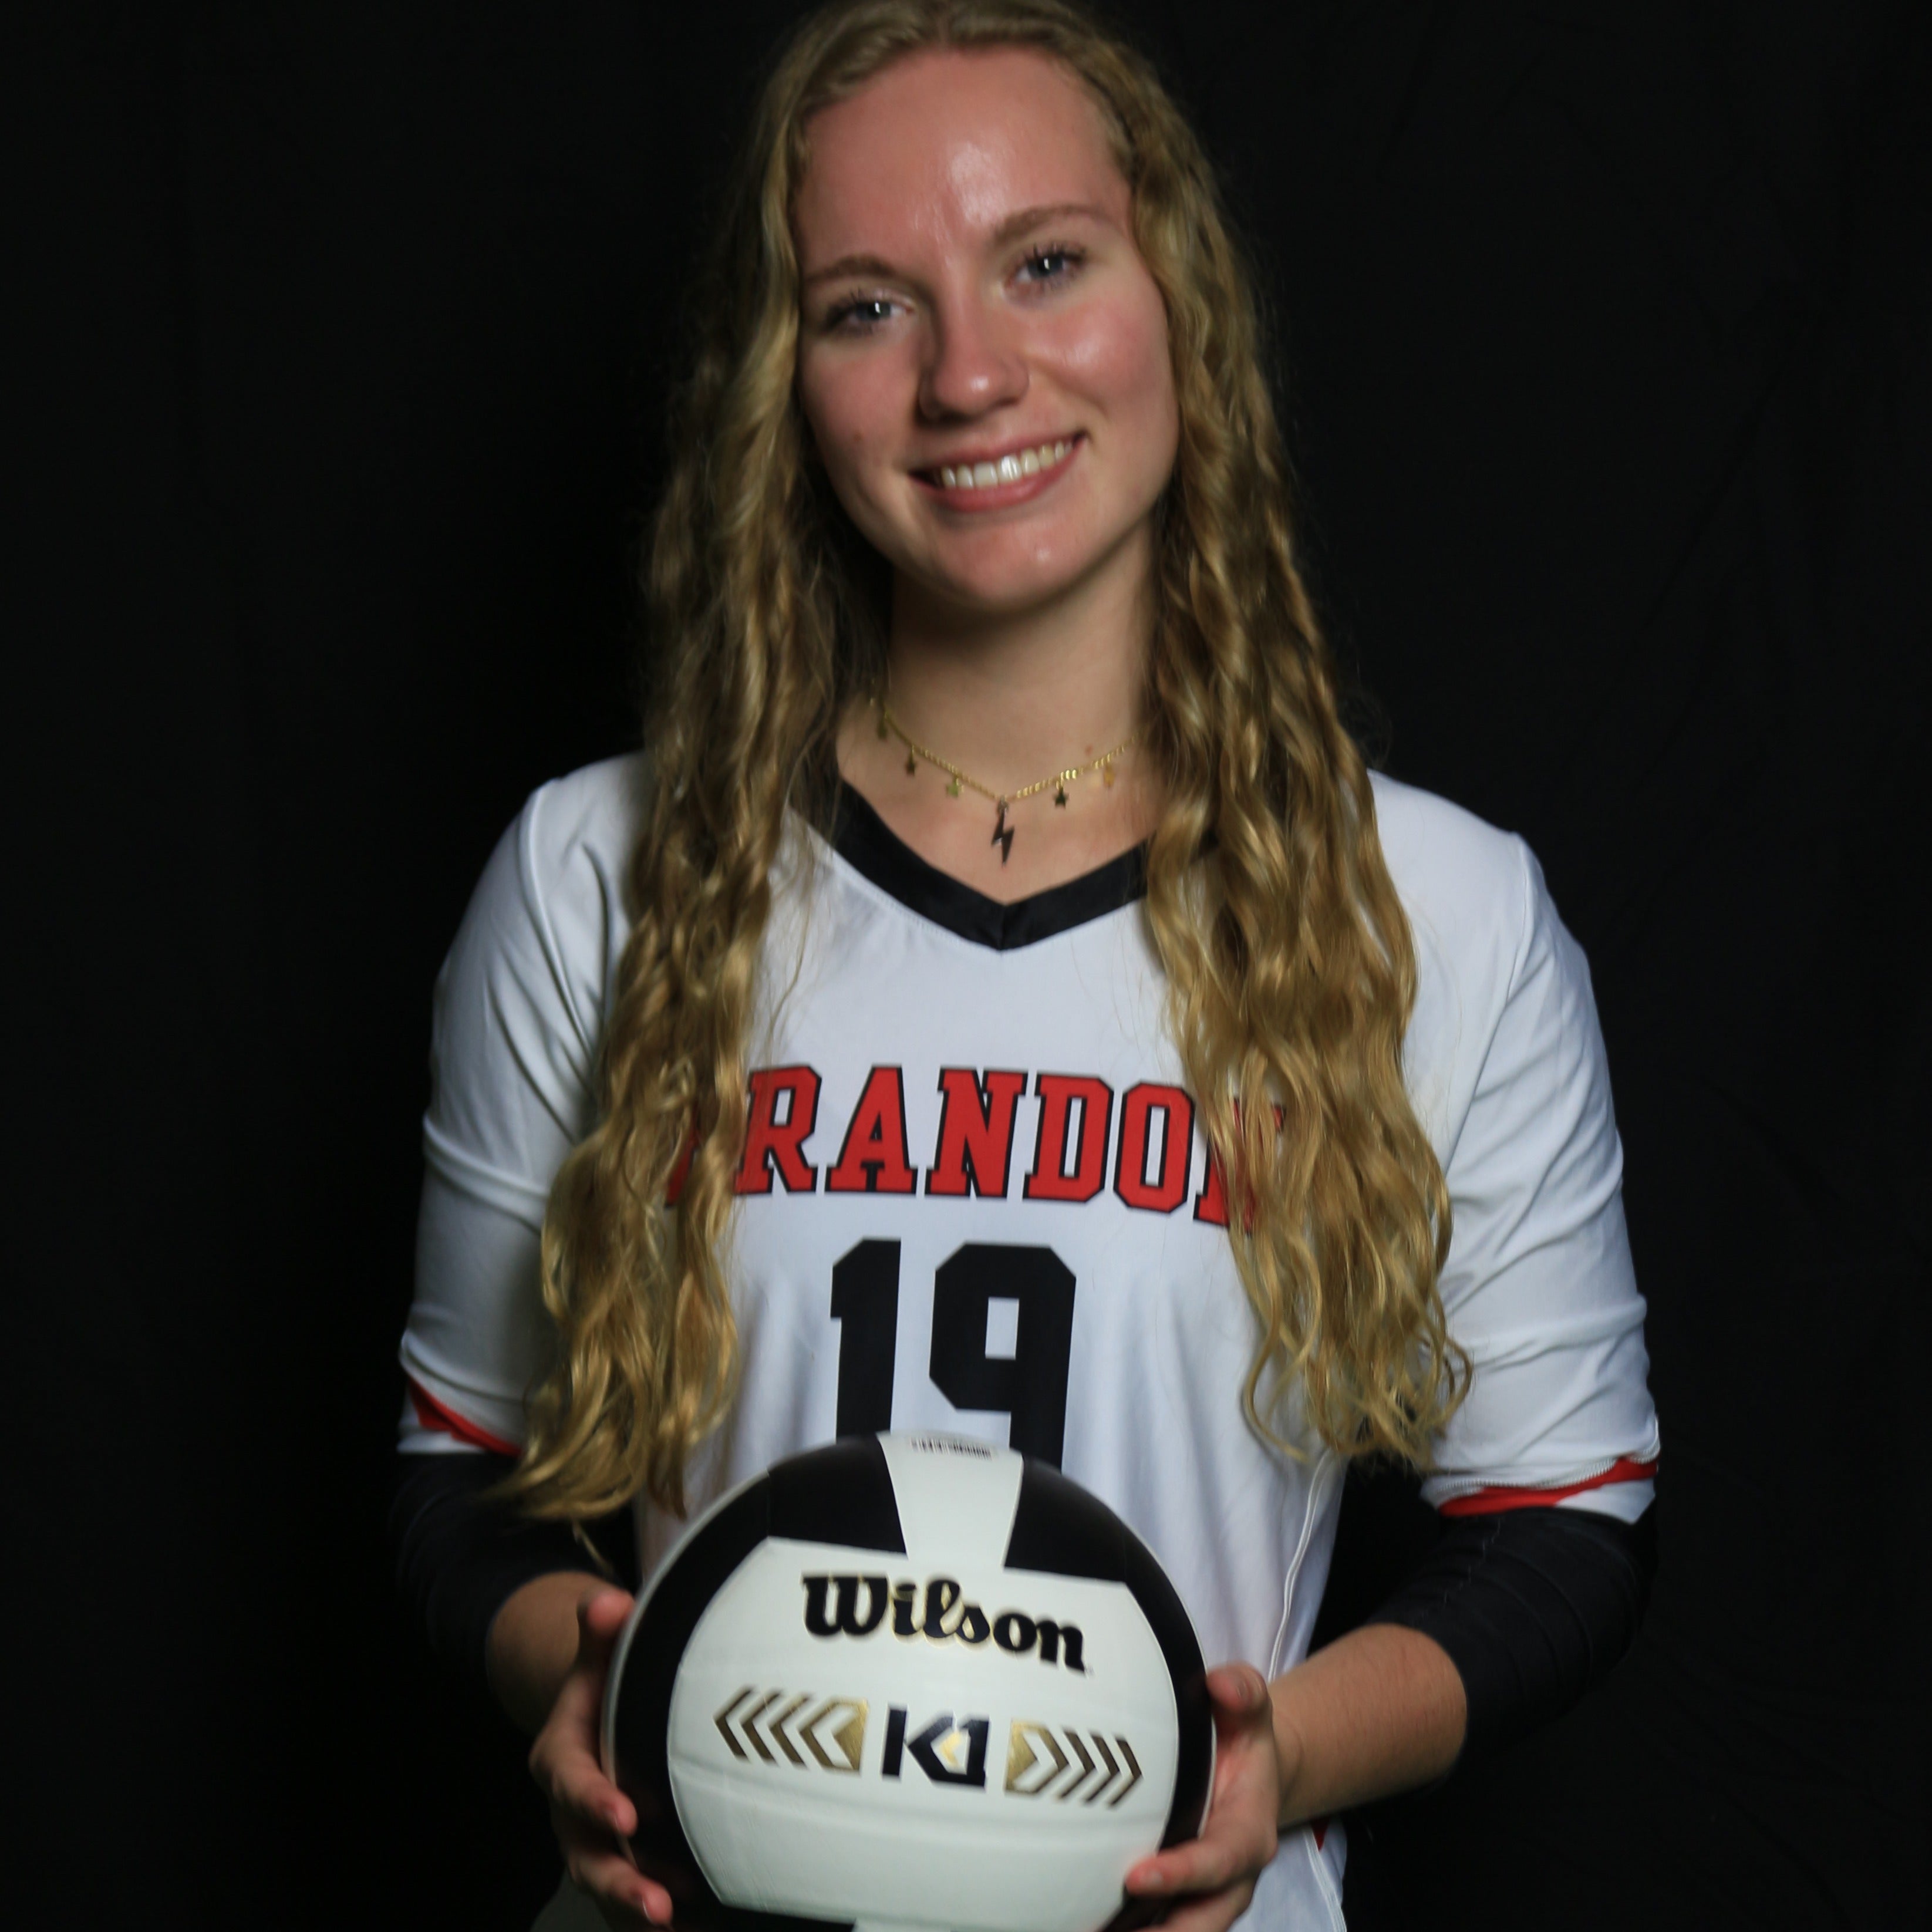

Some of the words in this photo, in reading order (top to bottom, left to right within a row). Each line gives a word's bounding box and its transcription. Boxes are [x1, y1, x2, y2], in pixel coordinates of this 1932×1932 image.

[665, 1065, 1284, 1236] RANDO
[830, 1238, 1076, 1472] 19
[801, 1571, 1087, 1675] Wilson
[881, 1705, 990, 1791] K1
